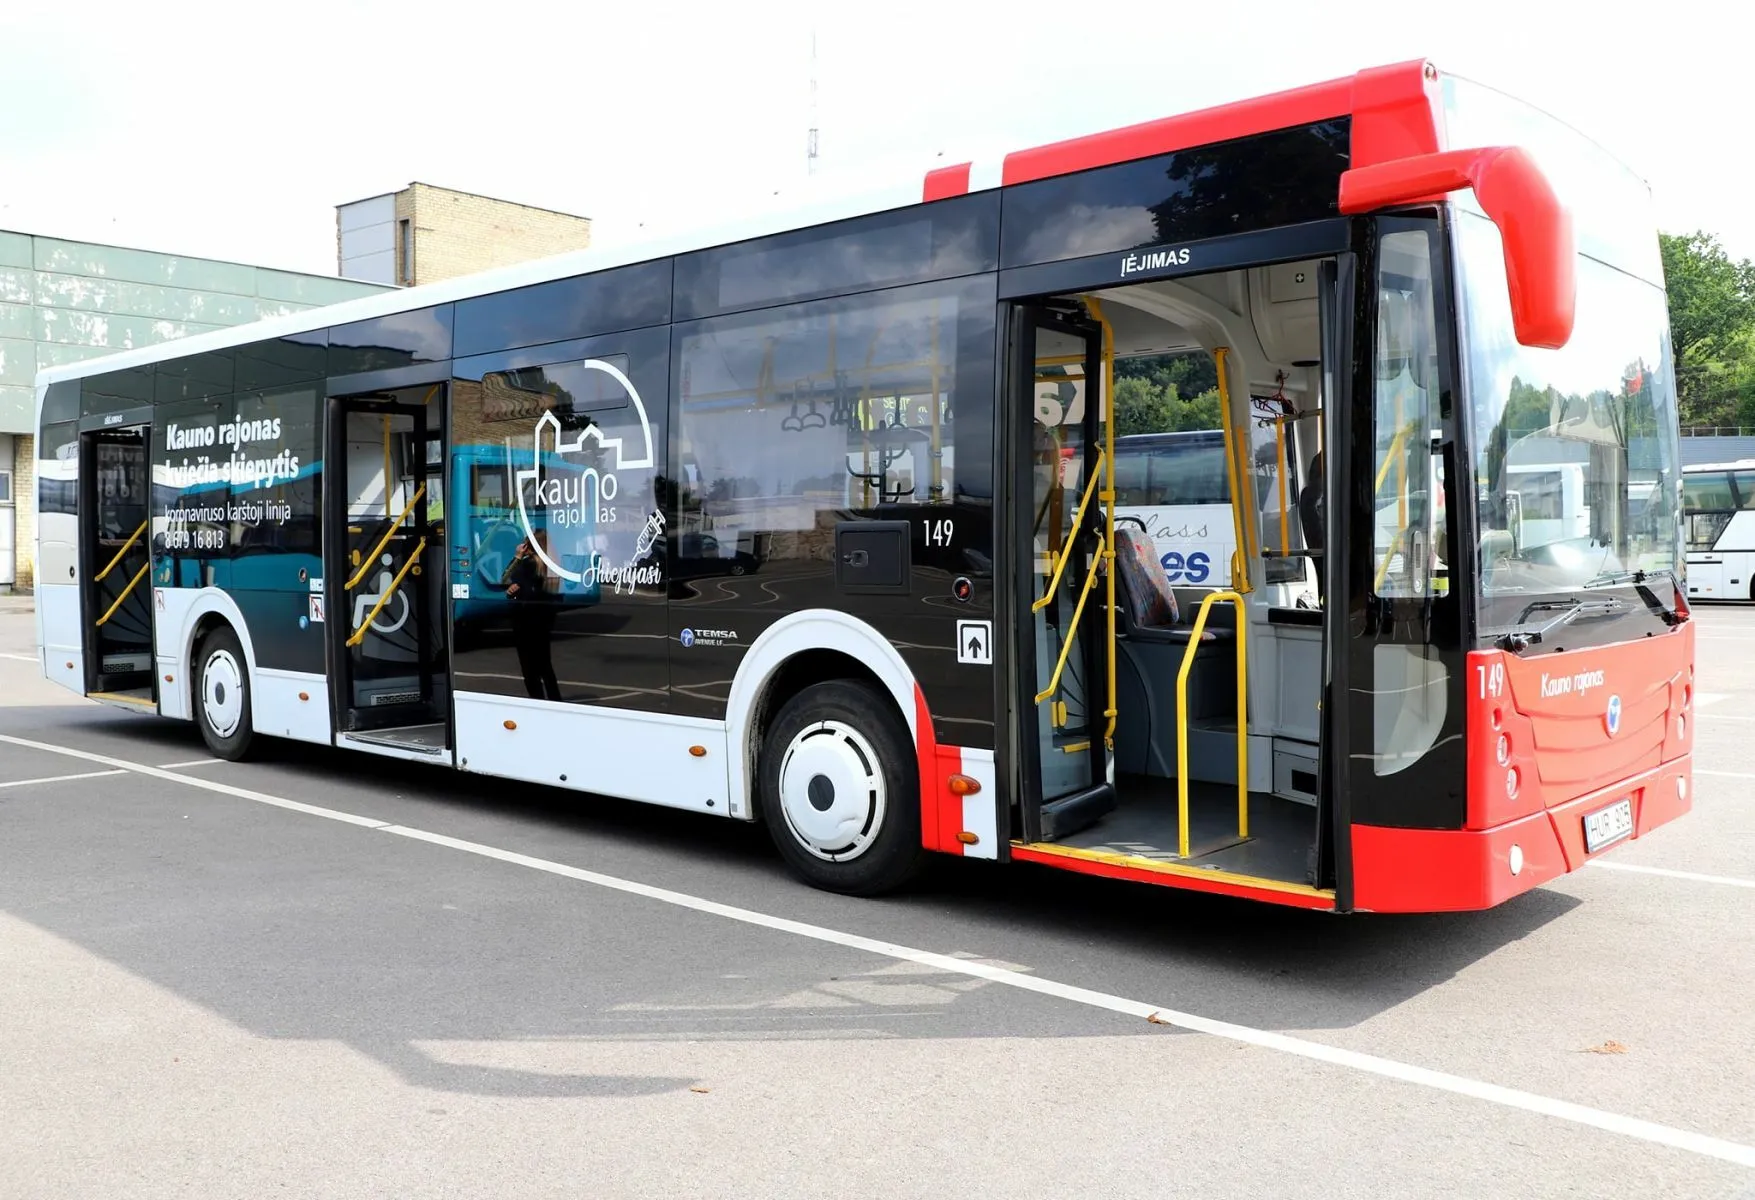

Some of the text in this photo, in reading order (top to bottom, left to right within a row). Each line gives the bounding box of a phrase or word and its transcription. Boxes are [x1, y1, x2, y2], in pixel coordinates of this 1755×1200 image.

[1120, 247, 1190, 278] ĮĖJIMAS
[166, 413, 281, 452] Kauno rajonas
[165, 455, 218, 486] kviečia
[222, 448, 299, 489] skiepytis
[164, 499, 292, 526] koronaviruso karštoji linija
[1115, 512, 1208, 539] lass
[164, 529, 224, 550] 8 679 16 813
[923, 519, 954, 547] 149
[694, 629, 738, 639] TEMSA
[1477, 662, 1504, 700] 149
[1541, 667, 1605, 698] Kauno rajonas
